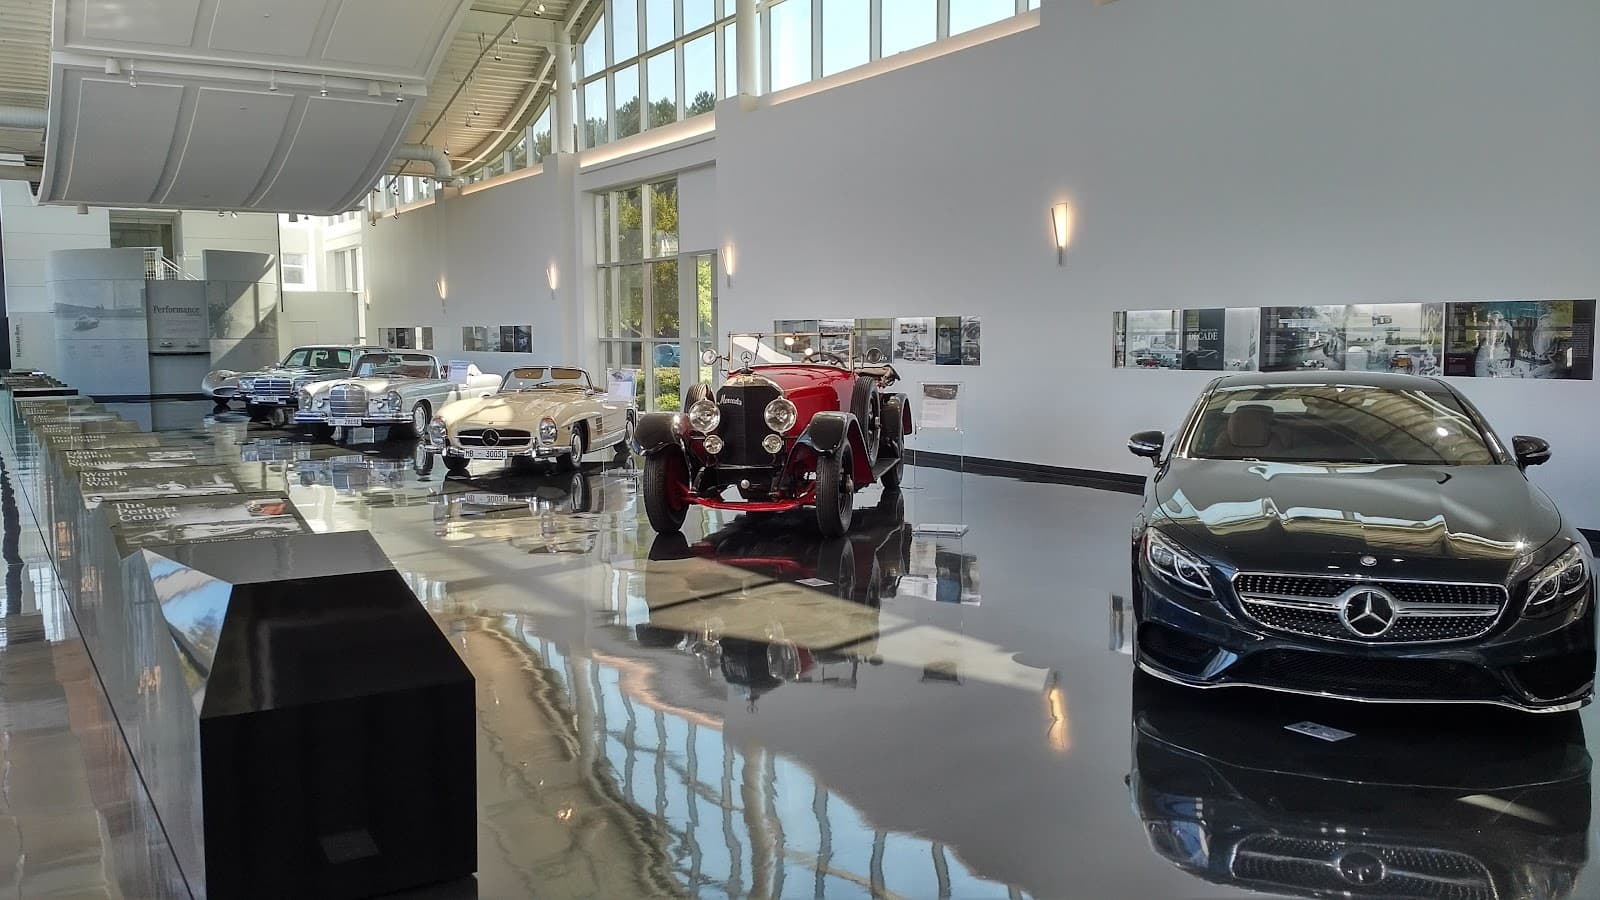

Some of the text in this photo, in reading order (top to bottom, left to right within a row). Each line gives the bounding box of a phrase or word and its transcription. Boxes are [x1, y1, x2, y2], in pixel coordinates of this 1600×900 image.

[153, 304, 200, 314] Performance
[1188, 332, 1218, 341] DECADE
[465, 450, 474, 458] MB
[485, 450, 506, 458] 300SL
[112, 502, 145, 510] The
[116, 505, 178, 516] Perfect
[120, 511, 181, 521] Couple
